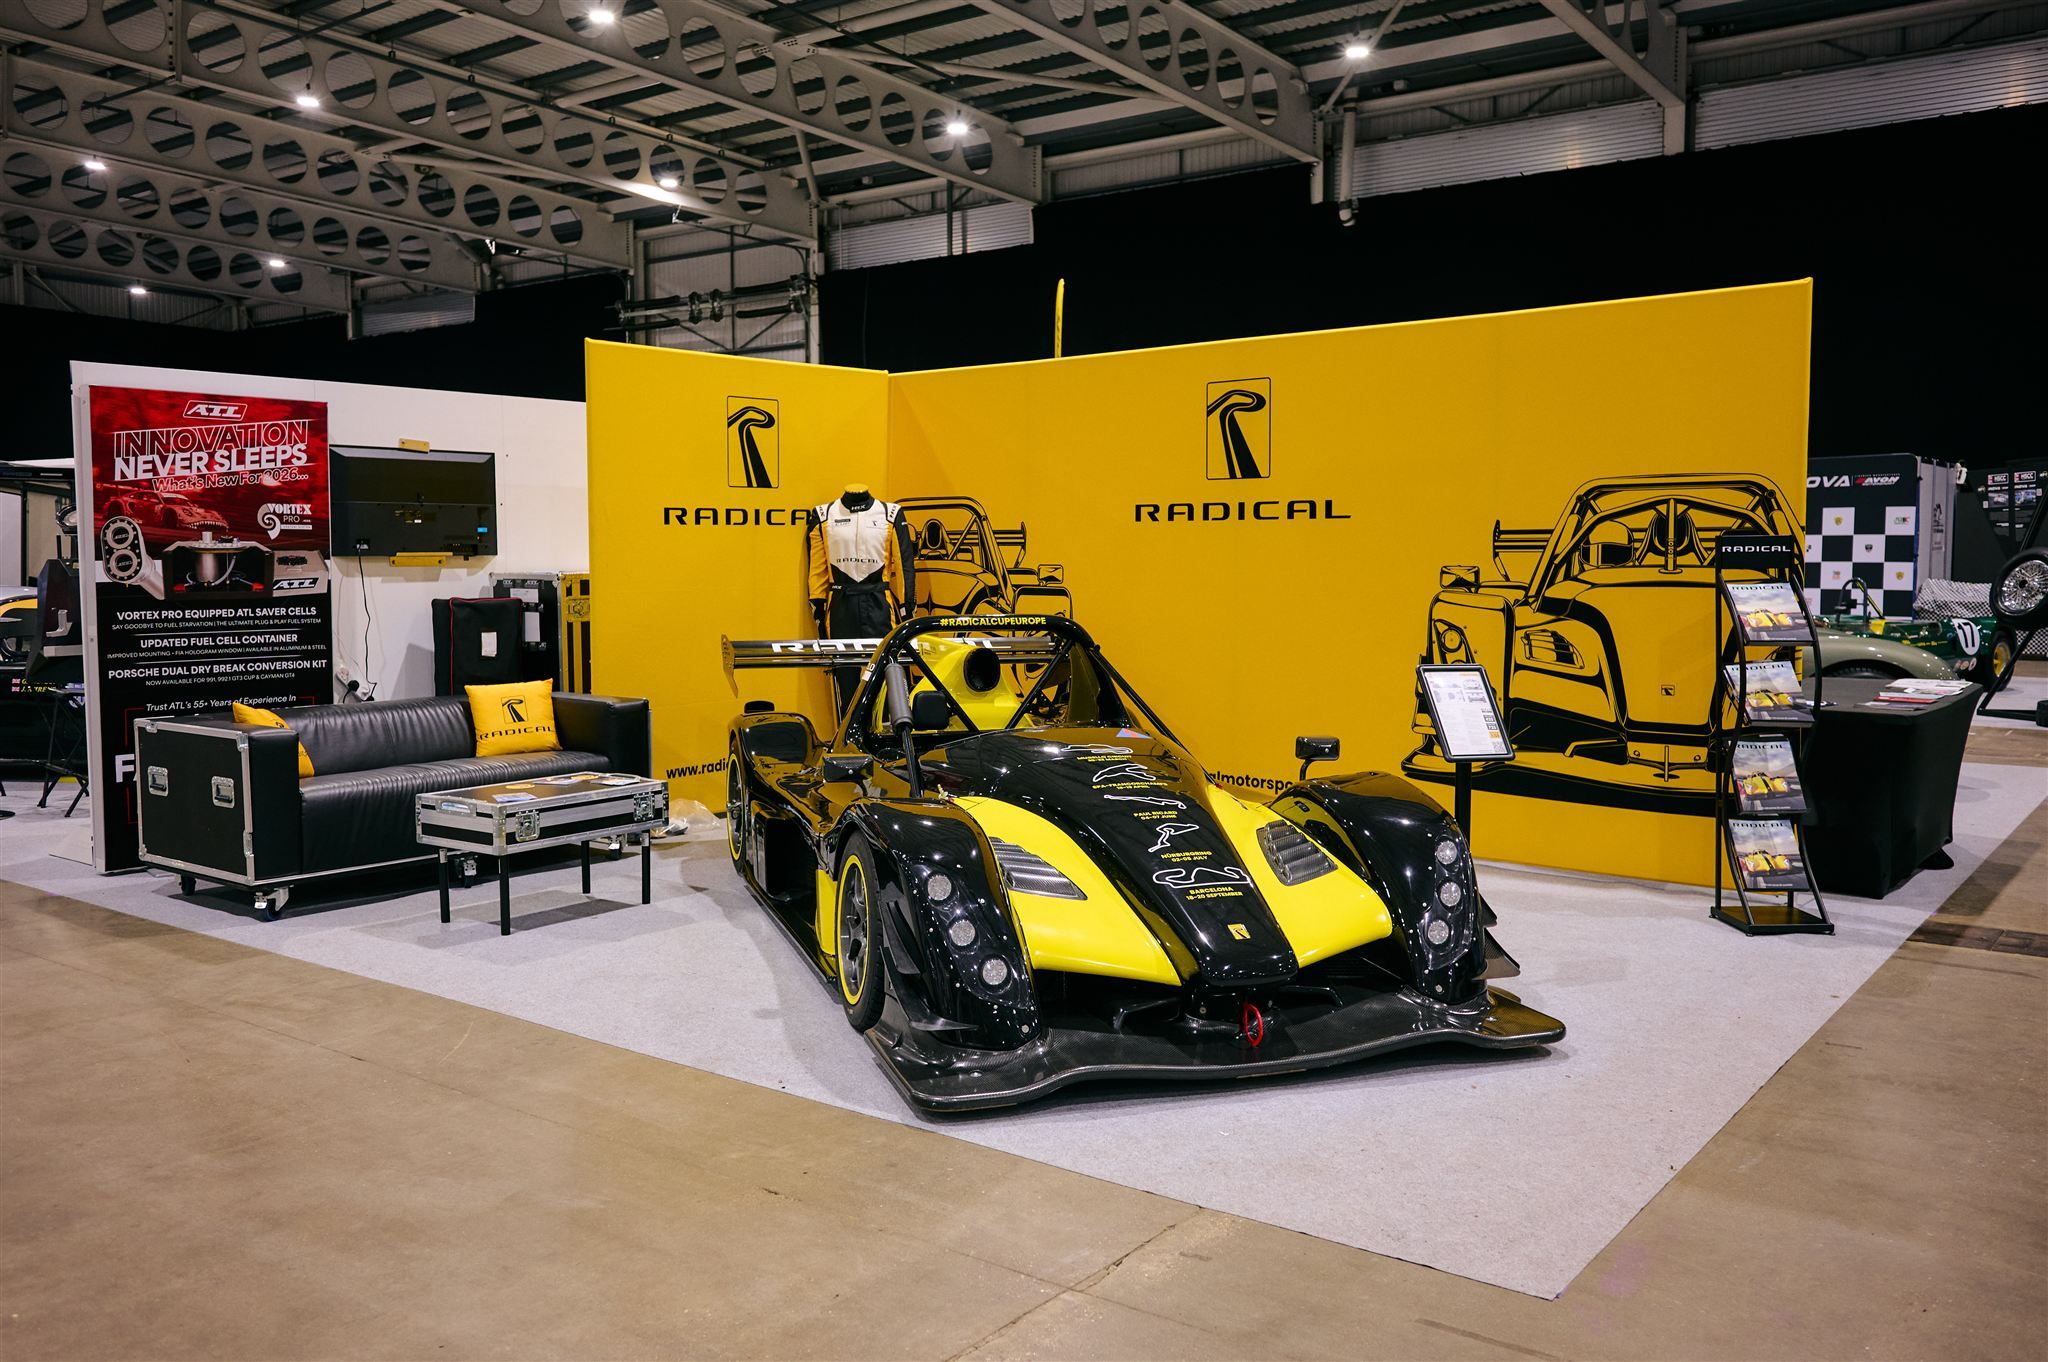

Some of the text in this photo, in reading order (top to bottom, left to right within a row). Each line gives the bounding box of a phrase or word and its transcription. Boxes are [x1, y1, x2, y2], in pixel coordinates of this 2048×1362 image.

[114, 420, 308, 459] INNOVATION
[115, 443, 308, 481] NEVER SLEEPS
[152, 467, 309, 492] What's New For 2026...
[1806, 475, 1850, 488] OVA
[266, 503, 312, 515] VORTEX
[1134, 499, 1352, 522] RADICAL
[283, 515, 300, 523] PRO
[663, 507, 811, 526] RADICA
[273, 579, 315, 590] ATL
[117, 606, 317, 620] VORTEX PRO EQUIPPED ATL SAVER CELLS
[940, 616, 1047, 627] #RADICALCUPEUROPE
[140, 634, 298, 648] UPDATED FUEL CELL CONTAINER
[1957, 622, 1976, 648] 17
[108, 660, 328, 680] PORSCHE DUAL DRY BREAK CONVERSION KIT
[146, 703, 168, 712] Trust
[168, 701, 192, 710] ATL's
[210, 699, 232, 707] Years
[243, 696, 288, 705] Experience
[480, 726, 556, 740] RADICAL
[1161, 851, 1212, 859] NÜRBURGRING
[1189, 886, 1234, 894] BARCELONA
